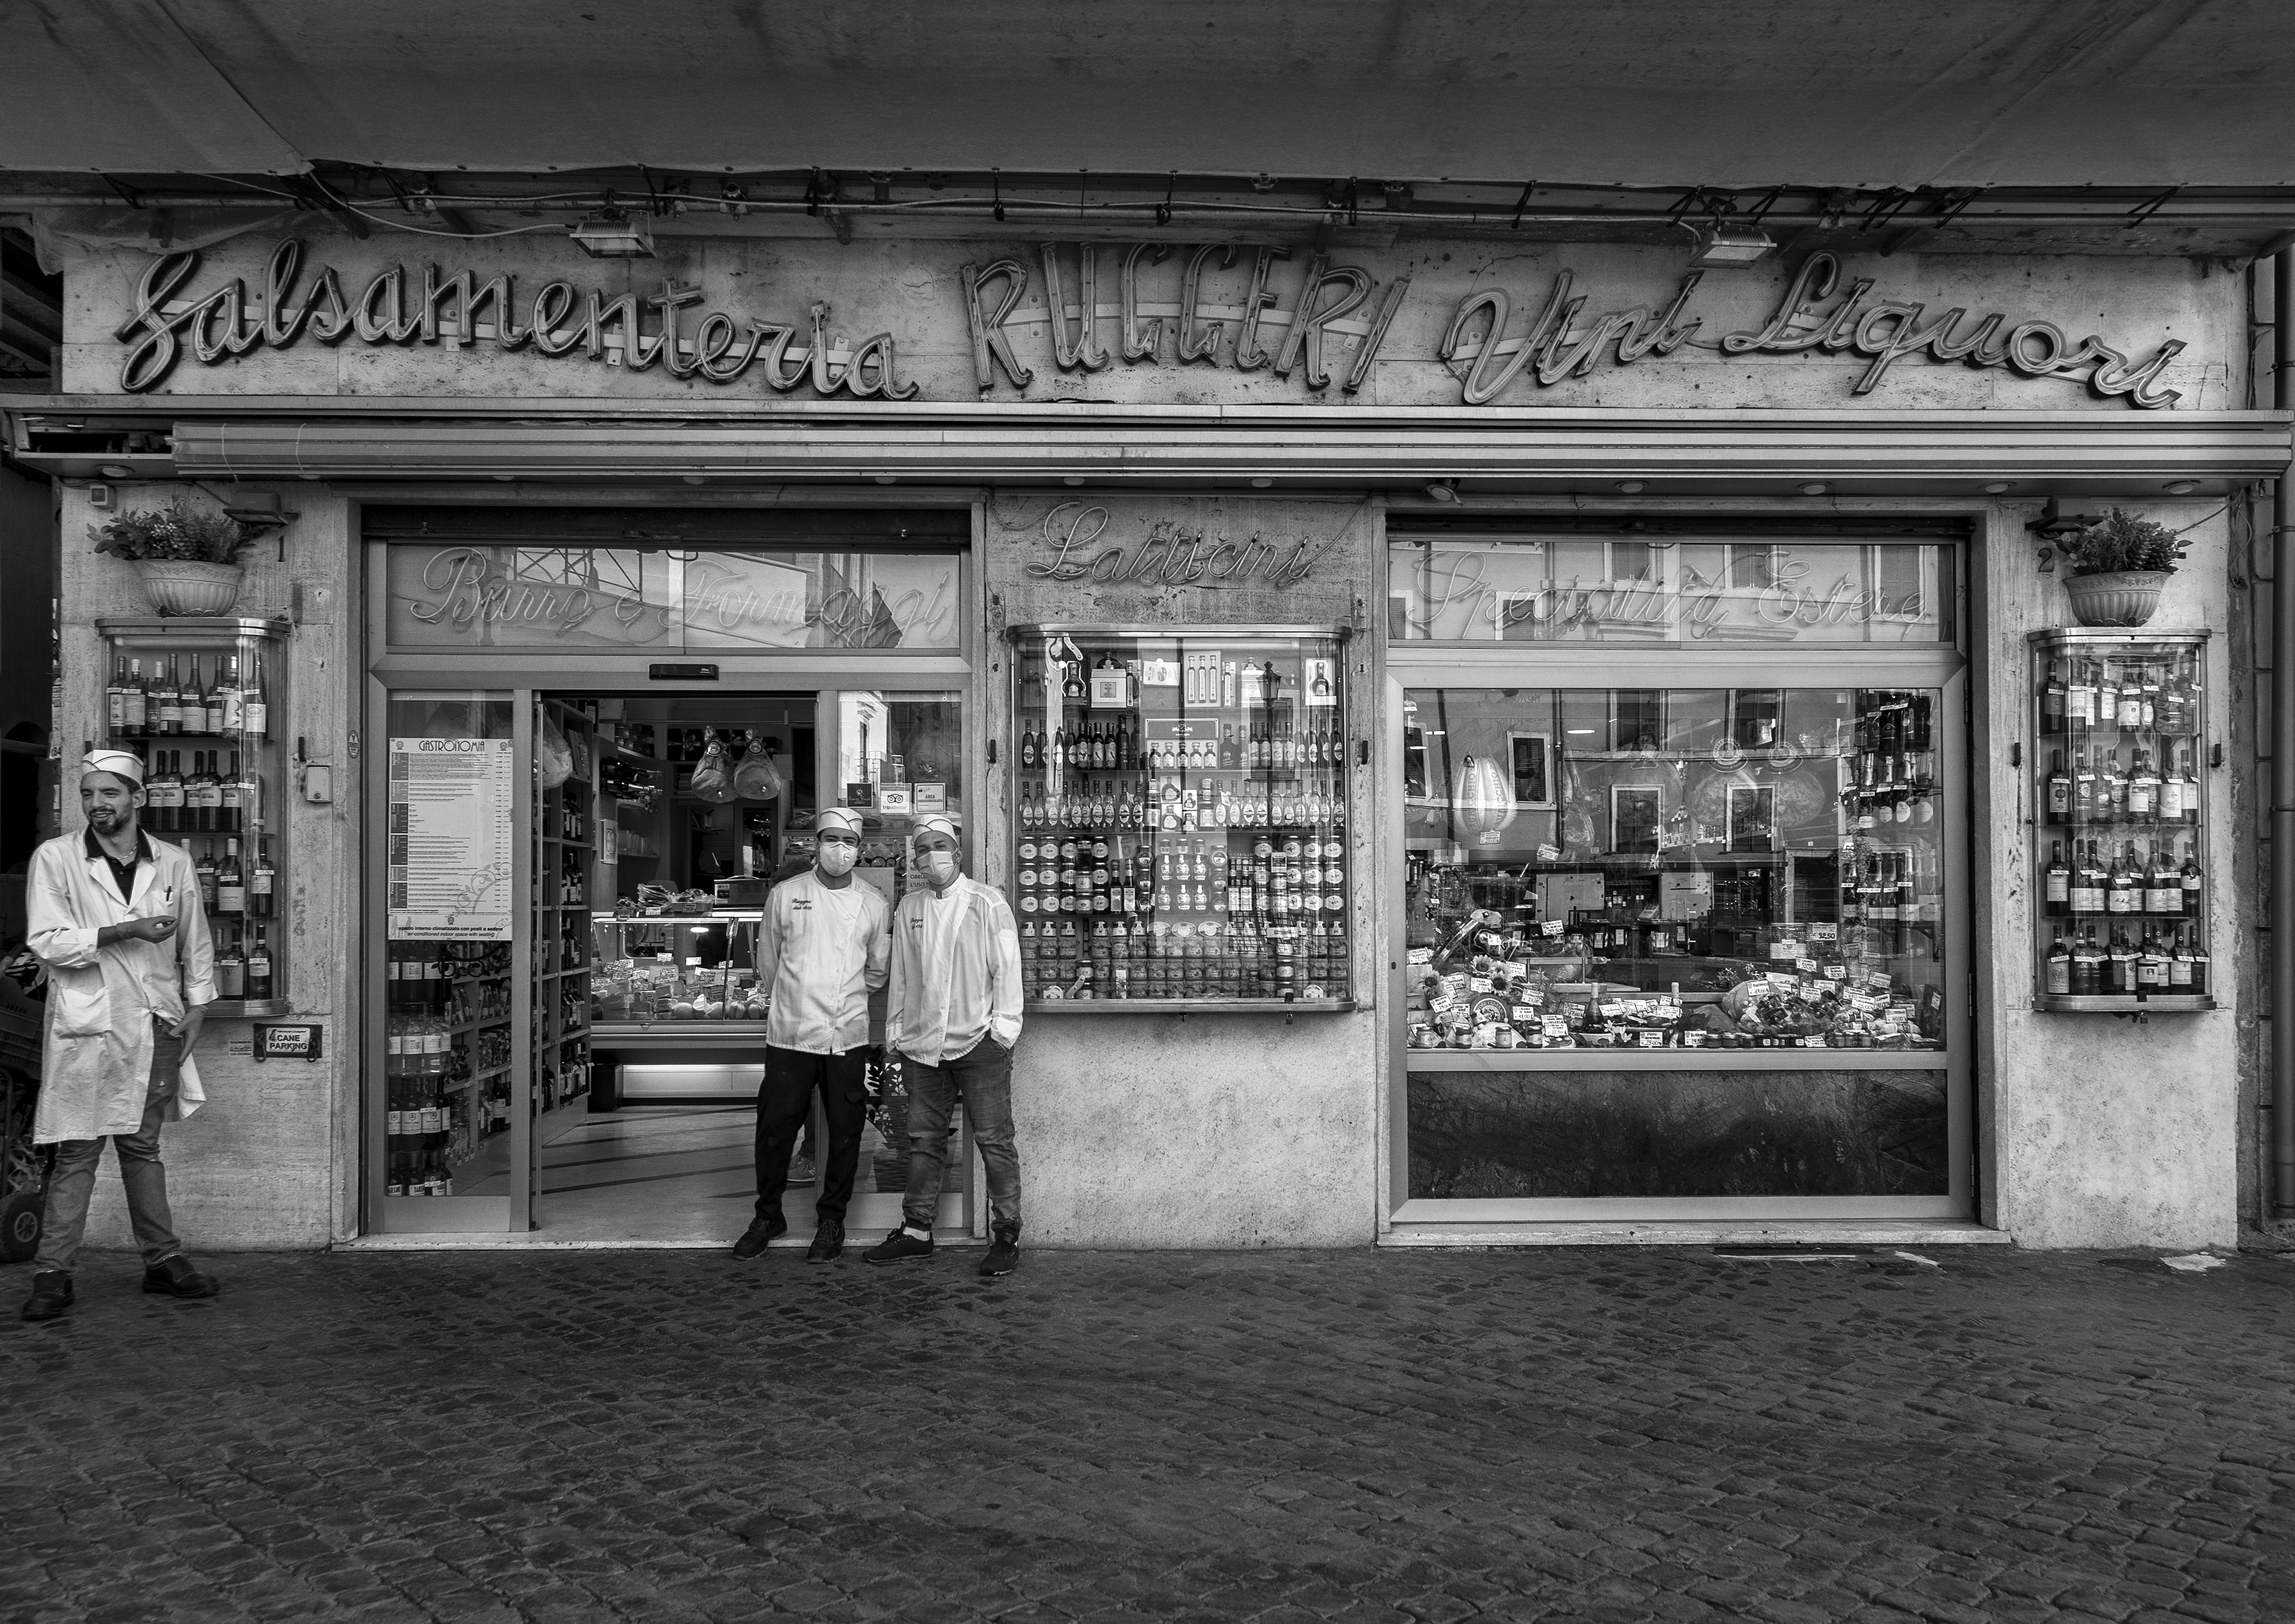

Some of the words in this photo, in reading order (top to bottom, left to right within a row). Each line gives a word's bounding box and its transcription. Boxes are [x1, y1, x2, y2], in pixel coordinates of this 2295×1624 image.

[961, 242, 1410, 394] RUGGERI
[1441, 268, 1704, 404] Vini
[1719, 250, 2188, 410] Liquori
[1026, 501, 1311, 585] Latticini
[410, 546, 594, 630] Burro
[657, 558, 956, 647] Formaggi
[1759, 552, 1927, 625] Estere
[419, 740, 485, 752] GASTRONOMIA
